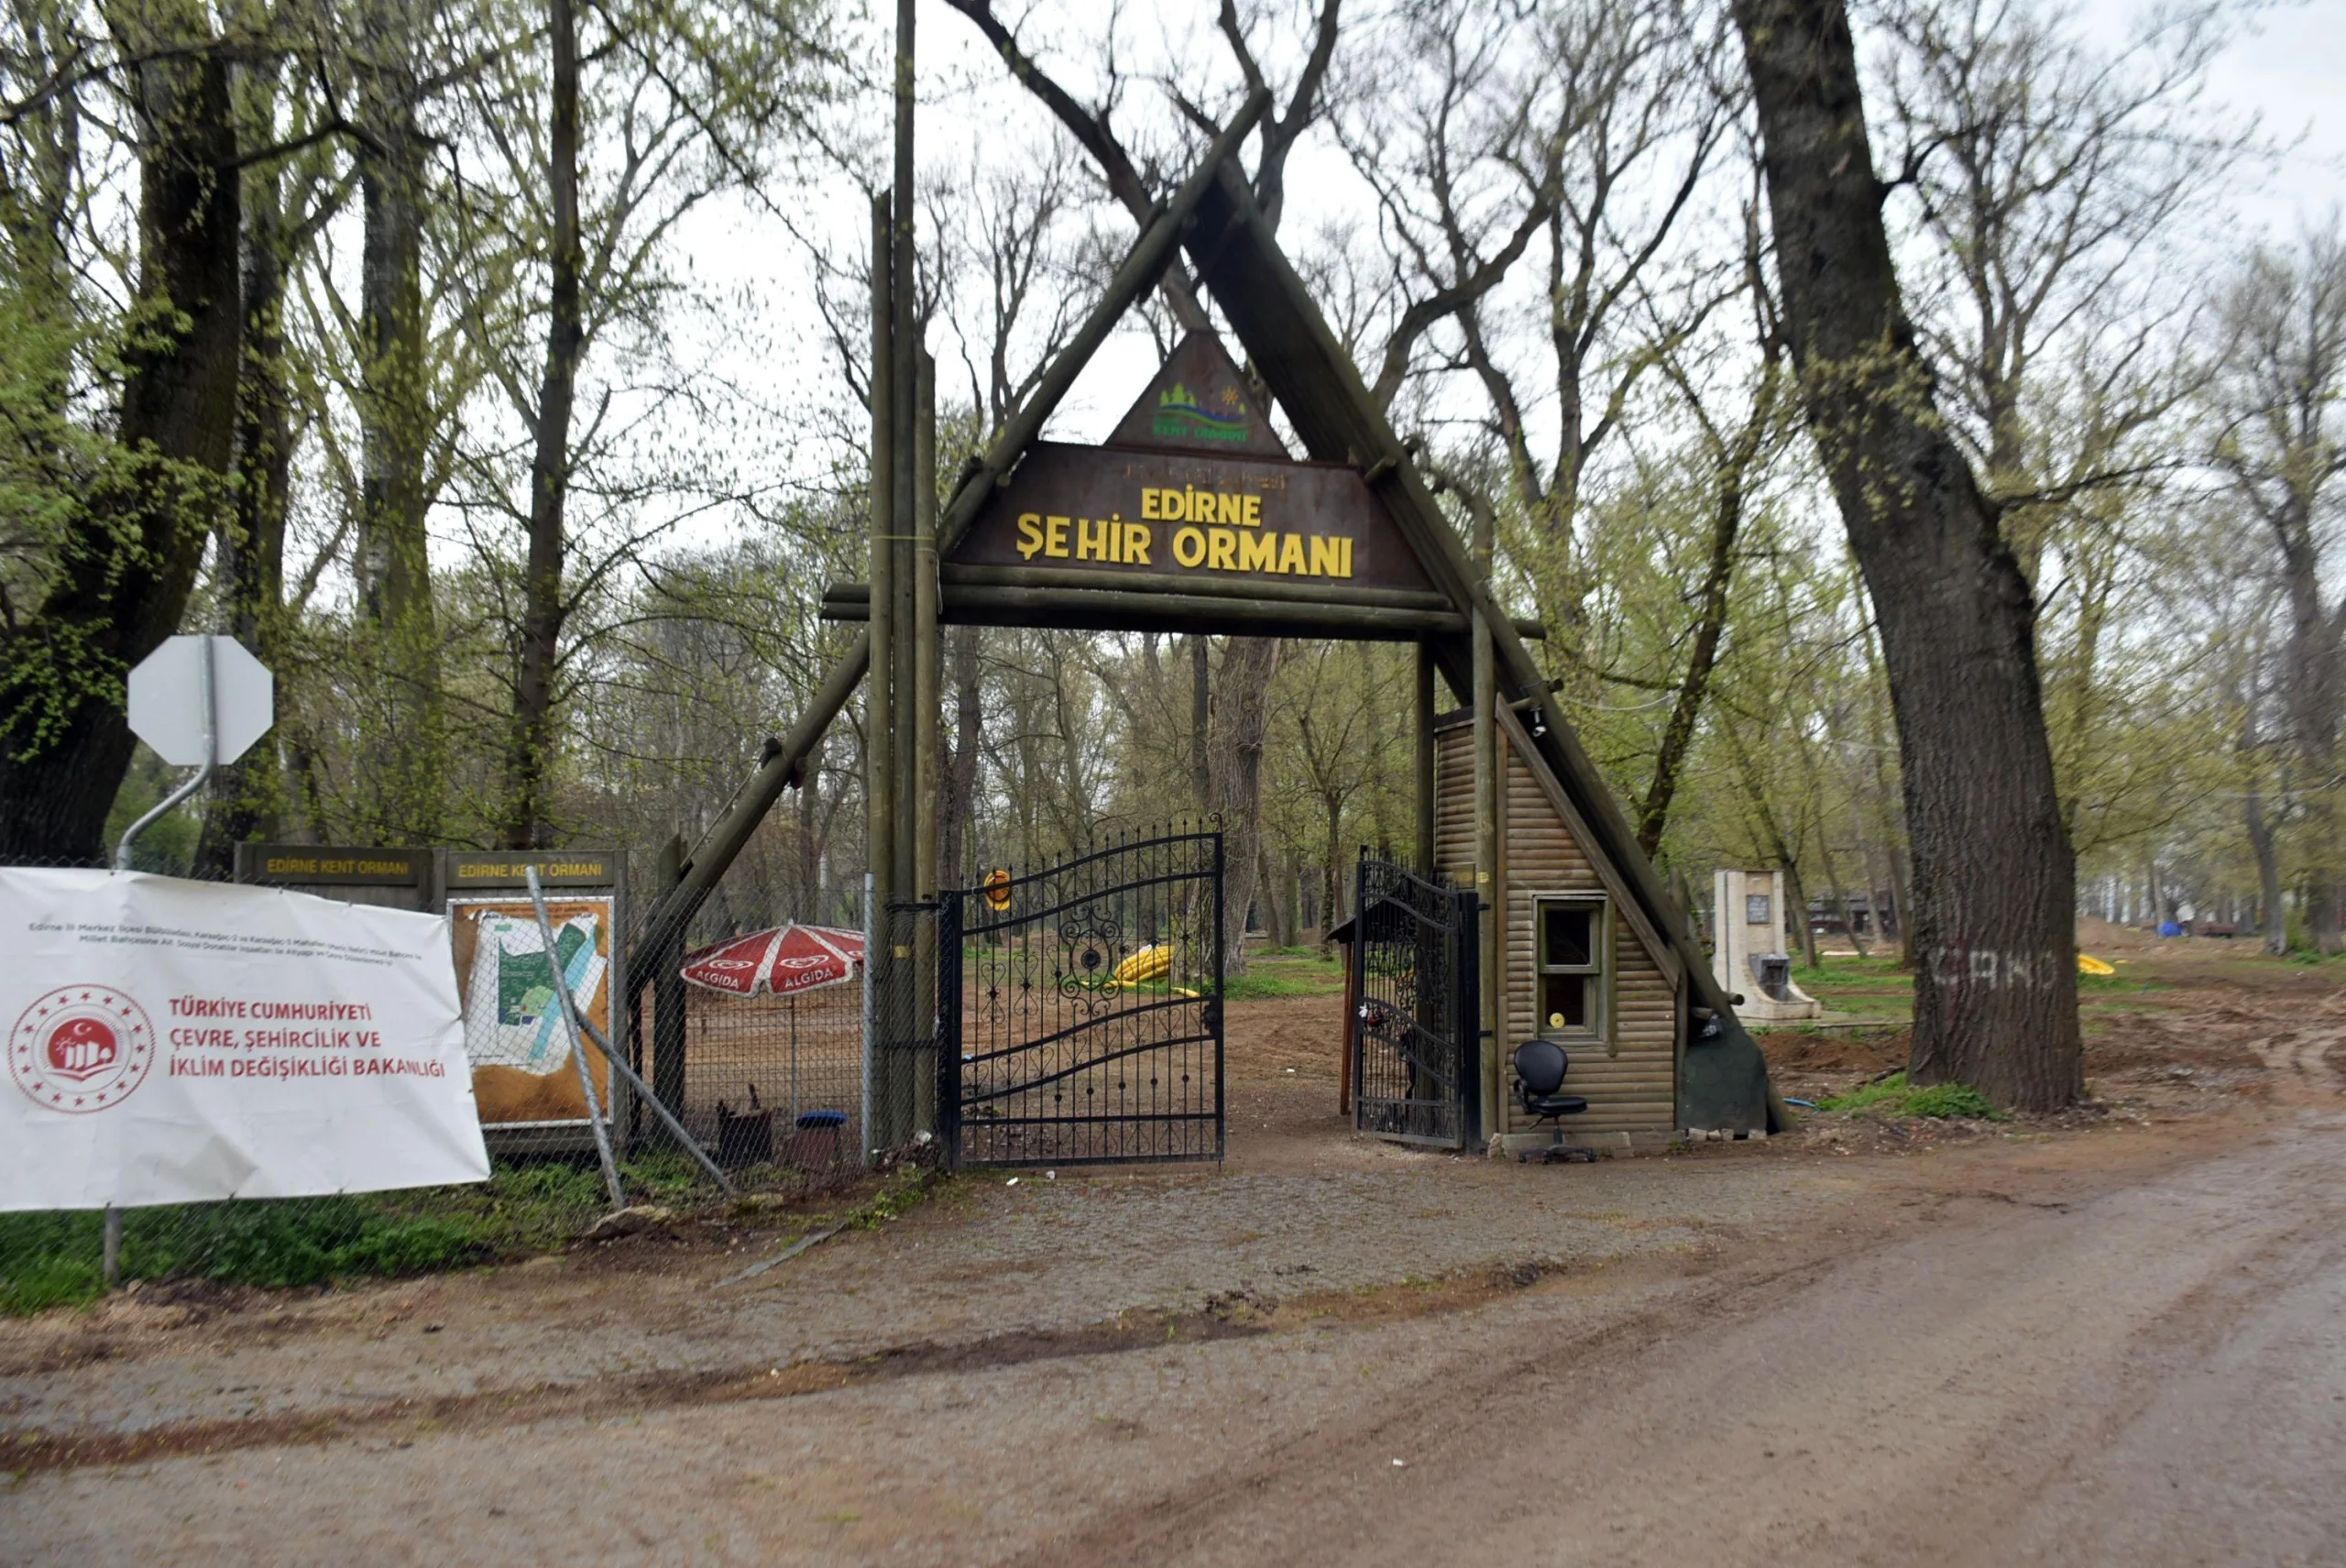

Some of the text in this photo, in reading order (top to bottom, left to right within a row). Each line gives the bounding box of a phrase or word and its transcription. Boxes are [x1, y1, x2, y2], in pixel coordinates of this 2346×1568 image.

[1141, 484, 1262, 528] EDİRNE
[1016, 512, 1354, 578] ŞEHİR ORMANI
[321, 859, 356, 874] KENT
[357, 860, 410, 875] ORMANI
[511, 863, 546, 877] KET
[550, 862, 602, 877] ORMANI
[696, 970, 740, 989] ALGIDA
[784, 969, 834, 989] ALGIDA
[169, 995, 373, 1021] TÜRKİYE CUMHURİYETİ
[170, 1027, 381, 1052] ÇEVRE, ŞEHİRCİLİK VE
[170, 1054, 446, 1081] İKLİM DEĞİŞİKLİĞİ BAKANLIĞI
